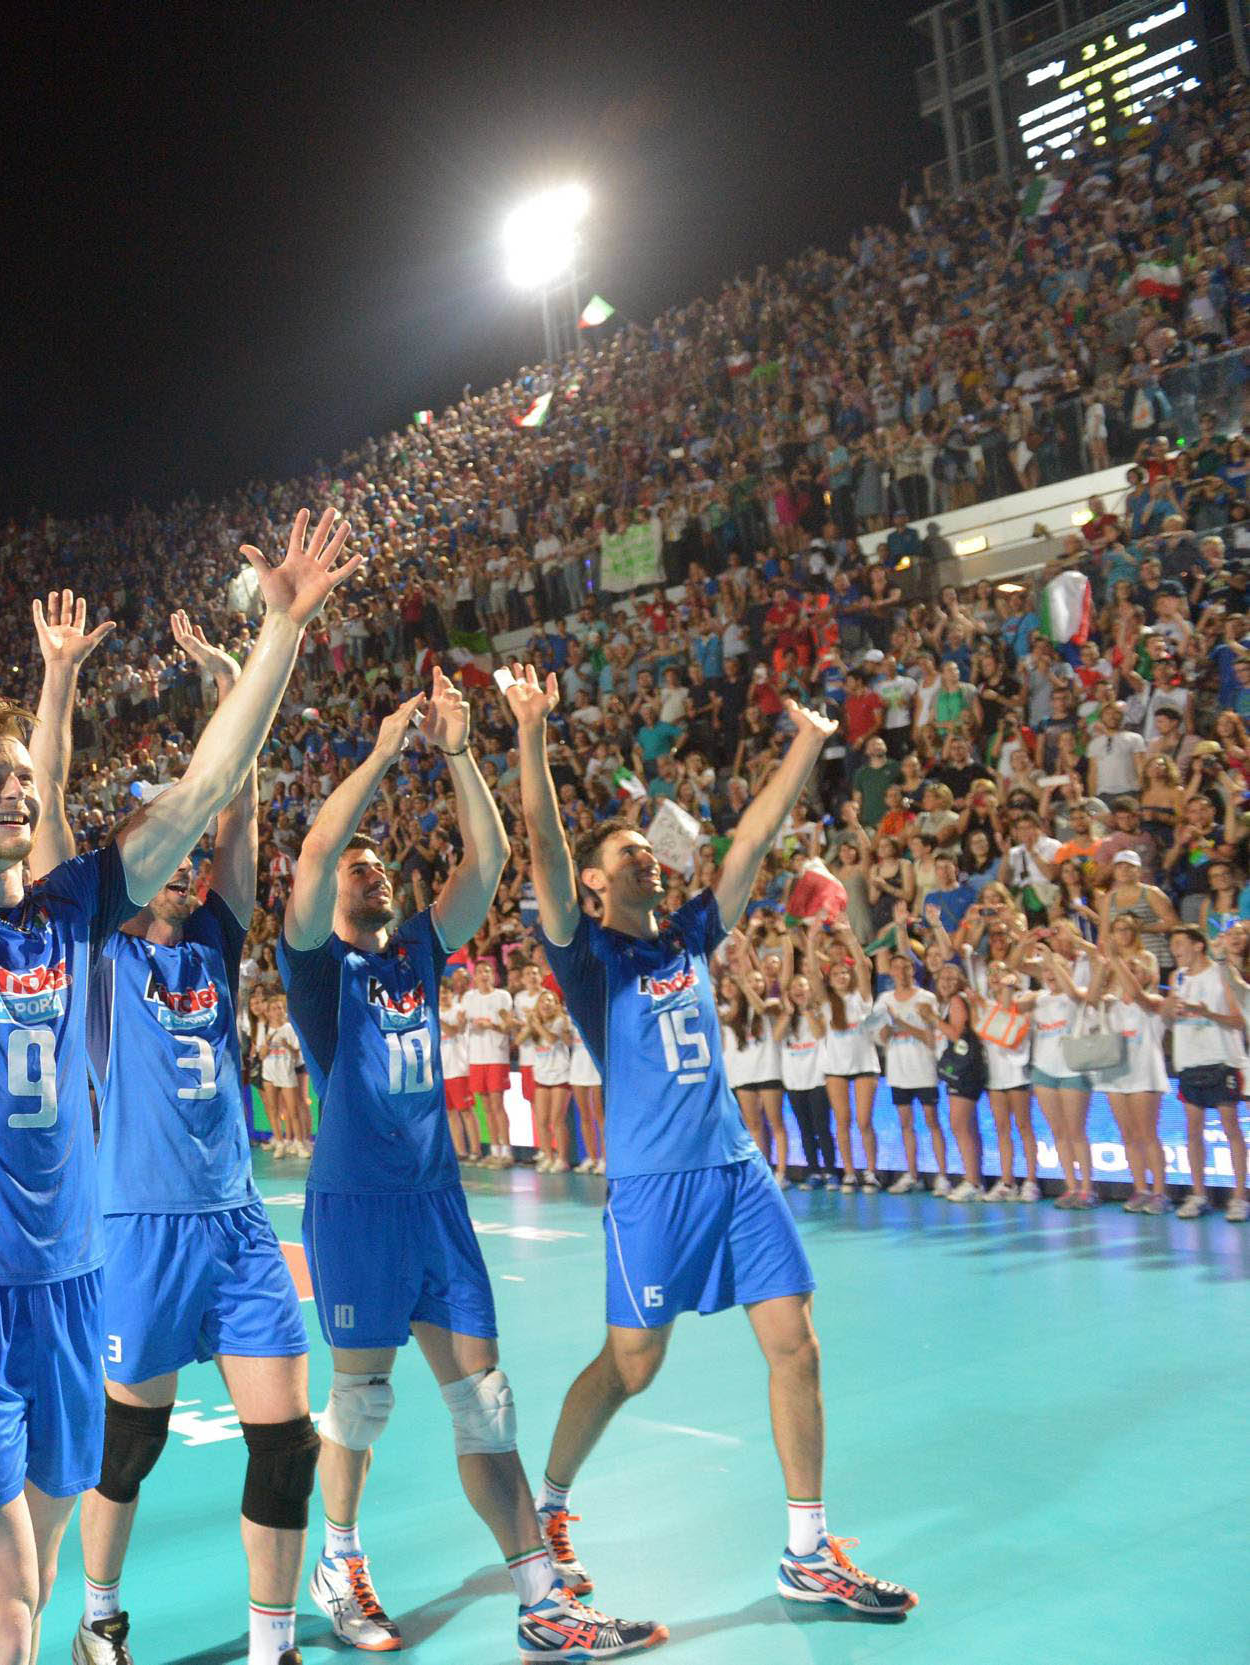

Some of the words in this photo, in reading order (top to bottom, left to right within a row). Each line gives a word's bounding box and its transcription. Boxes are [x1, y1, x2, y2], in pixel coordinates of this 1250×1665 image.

[174, 1035, 217, 1099] 3
[385, 1028, 434, 1094] 10
[658, 1008, 711, 1072] 15
[7, 1029, 58, 1128] 9
[334, 1304, 355, 1329] 10
[643, 1286, 664, 1307] 15
[108, 1335, 122, 1363] 3
